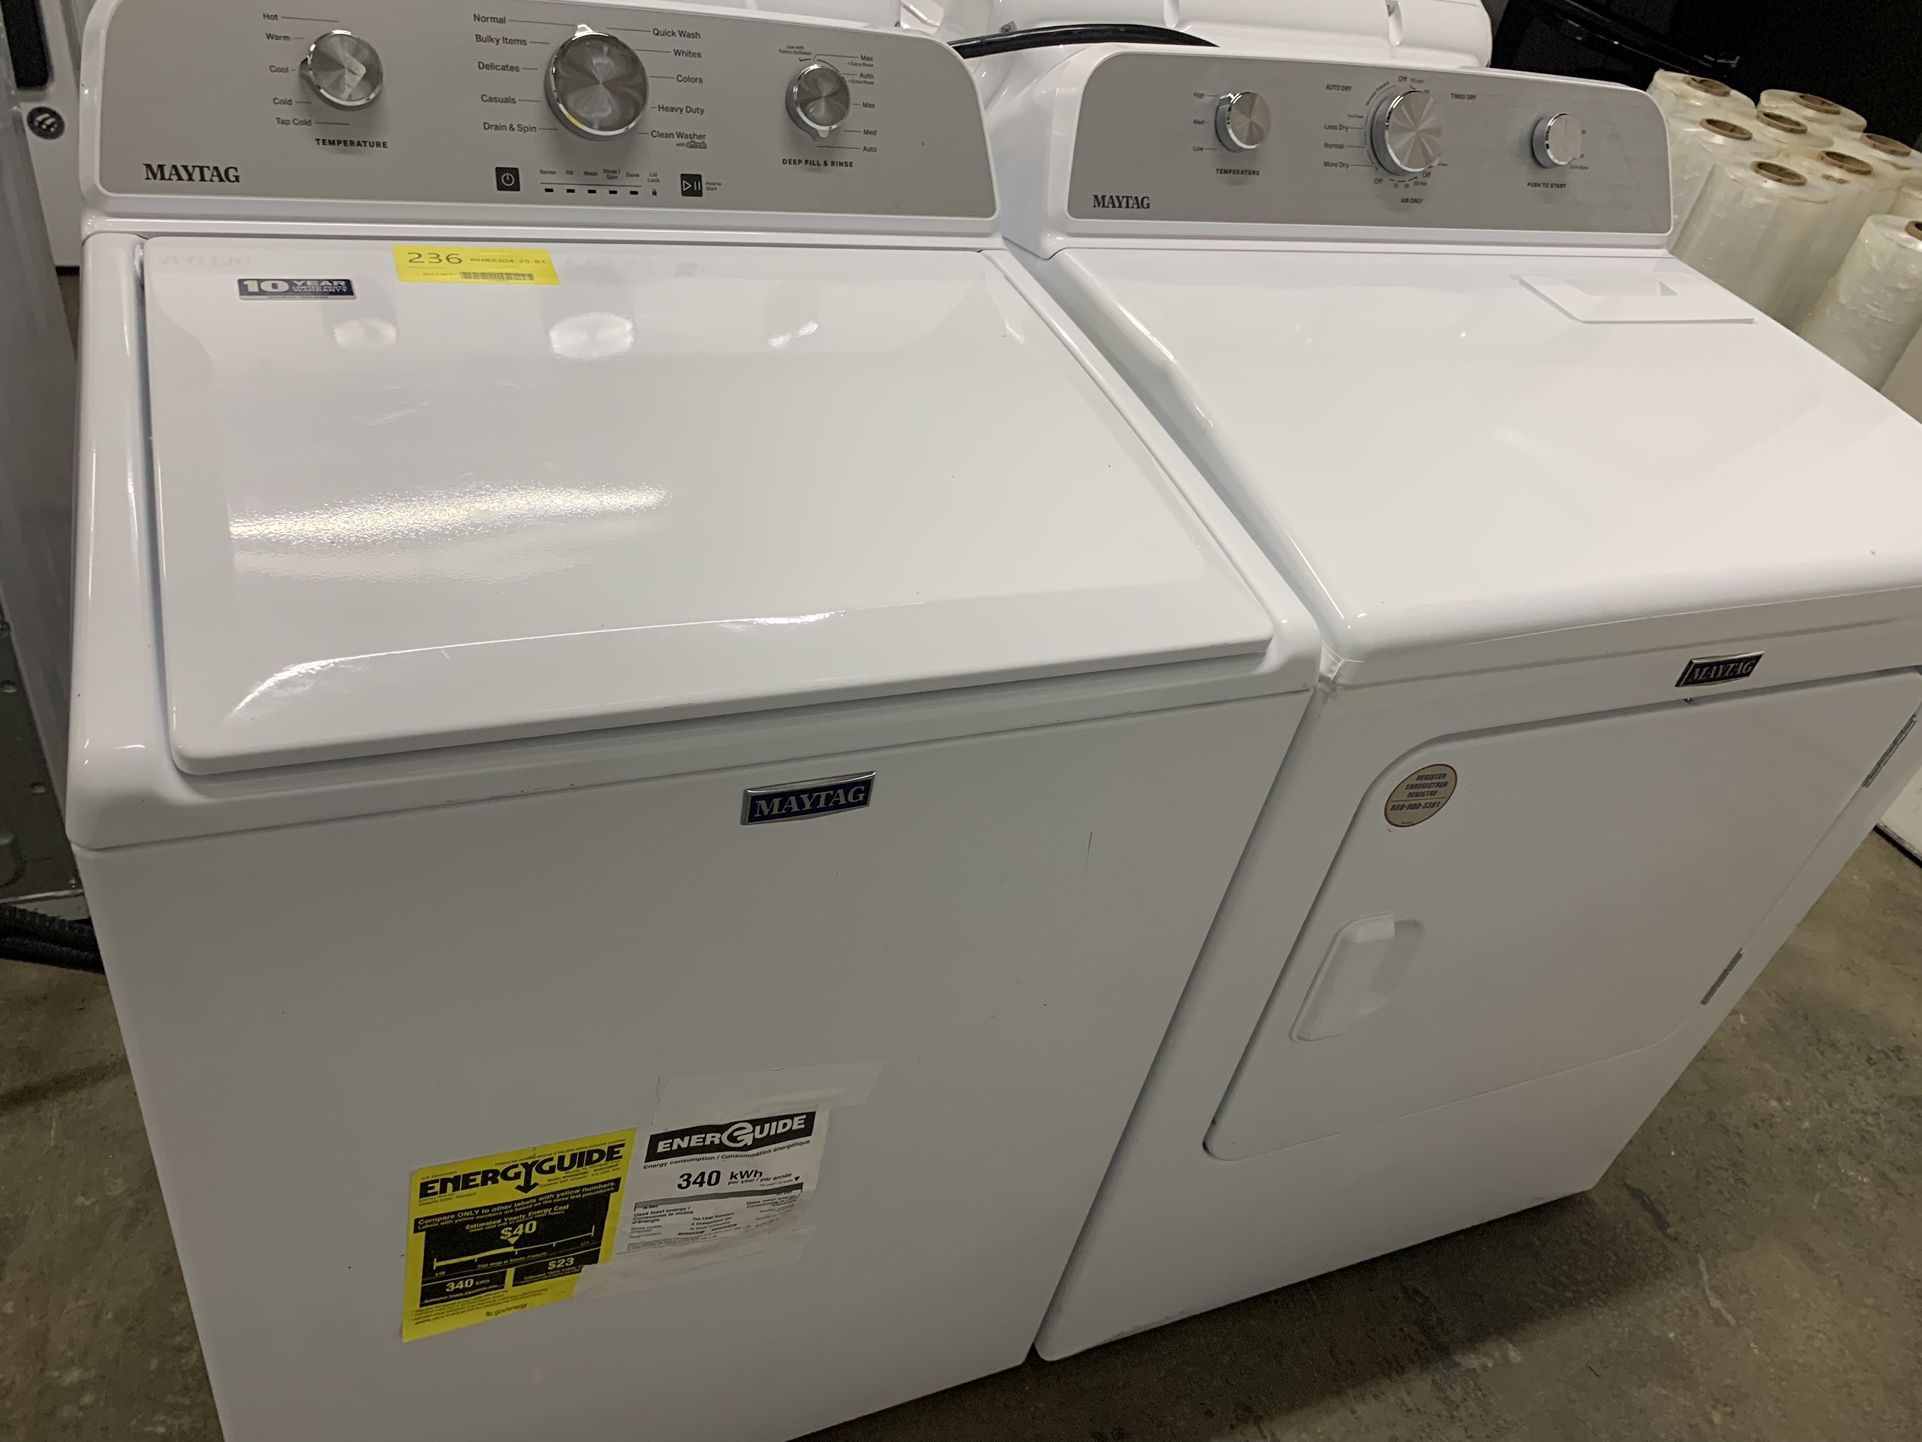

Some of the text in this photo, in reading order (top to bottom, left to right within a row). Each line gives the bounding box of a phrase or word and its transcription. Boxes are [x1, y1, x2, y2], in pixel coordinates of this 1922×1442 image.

[262, 13, 278, 21] Hot
[473, 14, 506, 24] Normal
[265, 33, 291, 42] Warm
[652, 28, 701, 39] Quick Wash
[475, 34, 527, 46] Bulky Items
[673, 49, 702, 59] Whites
[269, 65, 289, 74] Cool
[477, 61, 520, 72] Delicates
[676, 74, 703, 84] Colors
[272, 97, 293, 106] Cold
[480, 94, 516, 104] Casuals
[658, 104, 705, 116] Heavy Duty
[862, 101, 875, 109] Max
[275, 118, 312, 127] Tap Cold
[483, 122, 537, 134] Drain & Spin
[1338, 124, 1349, 133] Dry
[651, 130, 706, 141] Clean Washer
[315, 138, 388, 149] TEMPERATURE
[782, 158, 802, 166] DEEP
[804, 159, 822, 167] FILL
[830, 160, 853, 168] RINSE
[1338, 161, 1349, 170] Dry
[143, 163, 240, 184] MAYTAG
[1215, 168, 1260, 176] TEMPERATURE
[1092, 194, 1150, 210] MAYTAG
[407, 252, 463, 264] 236
[243, 280, 290, 292] 10
[1689, 660, 1756, 681] MAYTAG
[1415, 773, 1447, 781] REGISTER
[754, 785, 865, 817] MAYTAG
[656, 1115, 807, 1153] ENERGUIDE
[419, 1143, 626, 1193] ENERGYGUIDE
[643, 1161, 668, 1170] Energy
[669, 1155, 716, 1165] consumption
[677, 1169, 763, 1190] 340 kWh
[417, 1211, 456, 1226] Compare
[457, 1209, 480, 1219] ONLY
[492, 1203, 513, 1213] other
[513, 1197, 537, 1208] labels
[555, 1188, 580, 1200] yellow
[582, 1181, 615, 1192] numbers.
[465, 1217, 502, 1230] Estimated
[503, 1213, 526, 1224] Yearly
[528, 1207, 553, 1218] Energy
[499, 1220, 538, 1239] $40
[548, 1257, 575, 1270] $23
[445, 1278, 474, 1293] 340
